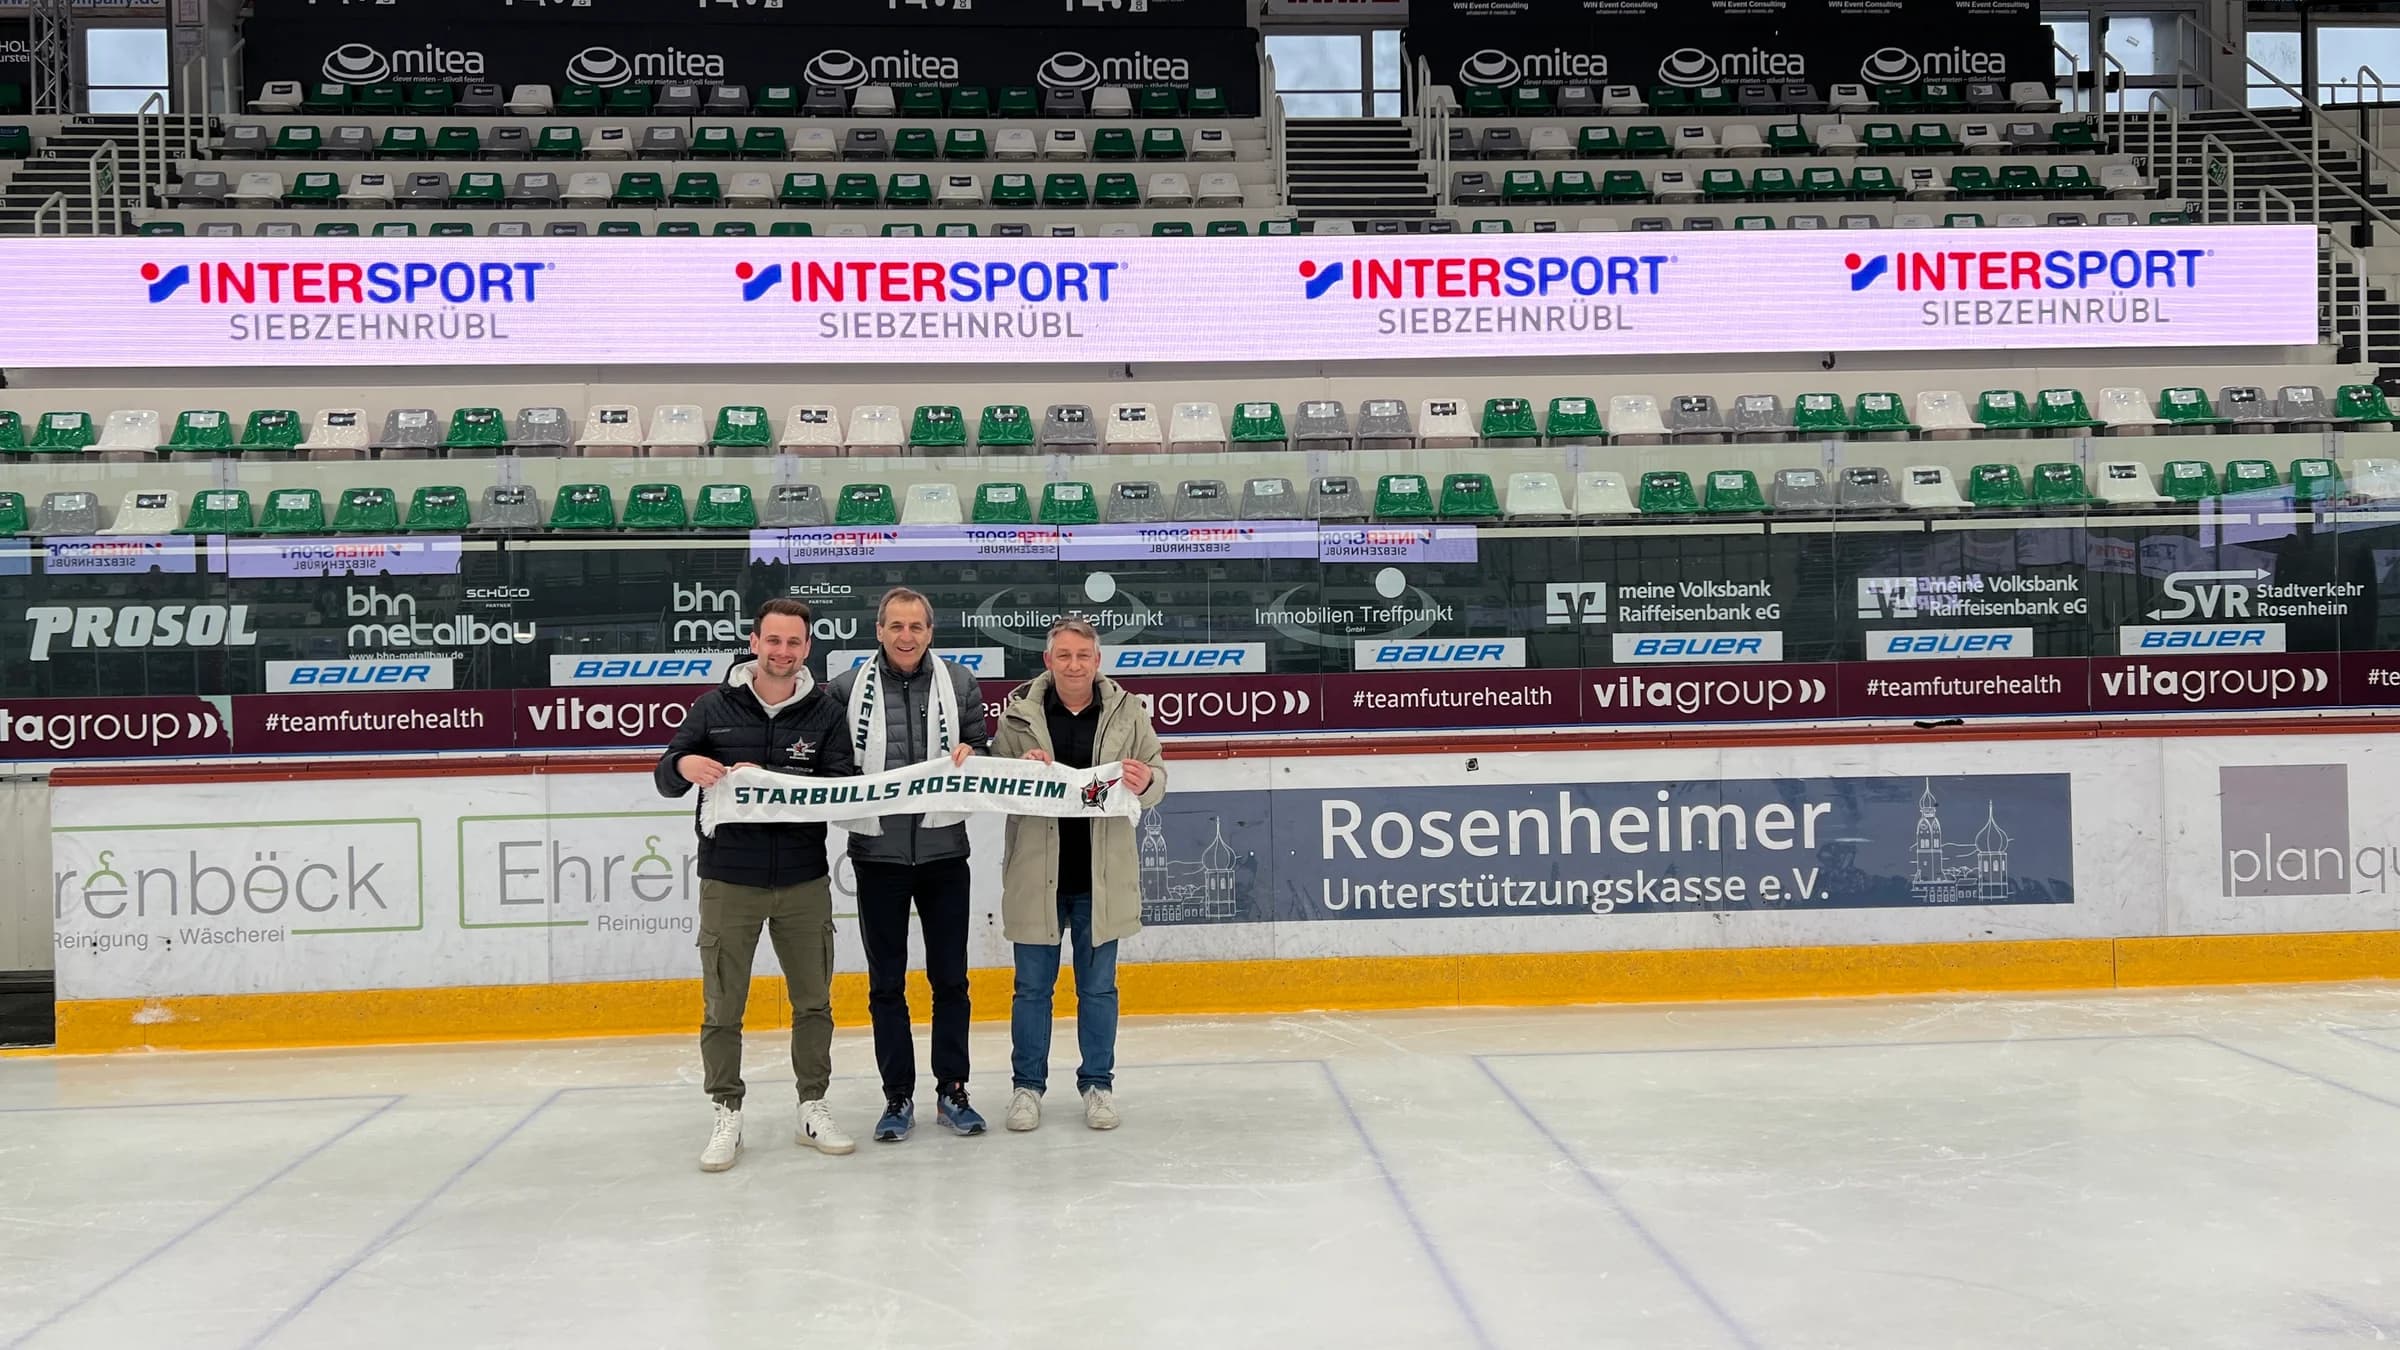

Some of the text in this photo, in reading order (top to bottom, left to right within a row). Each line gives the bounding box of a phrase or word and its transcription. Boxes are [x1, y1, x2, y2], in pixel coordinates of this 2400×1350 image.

[392, 43, 485, 74] mitea
[635, 46, 725, 76] mitea
[871, 49, 959, 79] mitea
[1103, 51, 1189, 81] mitea
[1523, 48, 1608, 76] mitea
[1721, 47, 1805, 75] mitea
[1924, 46, 2006, 74] mitea
[201, 262, 546, 303] INTERSPORT
[792, 261, 1118, 302] INTERSPORT
[1352, 256, 1668, 299] INTERSPORT
[1896, 250, 2205, 291] INTERSPORT
[230, 305, 509, 341] SIEBZEHNRÜBL
[819, 305, 1084, 339] SIEBZEHNRÜBL
[1378, 299, 1633, 334] SIEBZEHNRÜBL
[1922, 292, 2170, 325] SIEBZEHNRÜBL
[466, 585, 530, 598] SCHÜCO
[673, 582, 741, 612] bhn
[790, 582, 852, 594] SCHÜCO
[1619, 580, 1771, 599] meine Volksbank
[1989, 574, 2079, 593] Volksbank
[2155, 569, 2258, 620] SVR
[2256, 582, 2365, 598] Stadtverkehr
[346, 587, 416, 617] bhn
[1255, 605, 1453, 625] Immobilien Treffpunkt
[1619, 603, 1780, 622] Raiffeisenbank eG
[1930, 598, 2088, 617] Raiffeisenbank eG
[25, 605, 257, 661] PROSOL
[347, 615, 536, 647] metallbau
[1887, 633, 2013, 653] BAUER
[2140, 629, 2266, 648] BAUER
[1116, 648, 1245, 668] BAUER
[1375, 643, 1505, 663] BAUER
[1634, 637, 1763, 656] BAUER
[289, 665, 431, 685] BAUER
[573, 660, 712, 678] BAUER
[1352, 686, 1552, 708] #teamfuturehealth
[1592, 675, 1793, 714] vitagroup
[1867, 674, 2062, 696] #teamfuturehealth
[2101, 665, 2296, 703] vitagroup
[265, 708, 485, 733] #teamfuturehealth
[528, 697, 687, 737] vitagro
[734, 775, 1067, 805] STARBULLS ROSENHEIM
[1320, 790, 1832, 862] Rosenheimer
[1323, 866, 1829, 914] Unterstützungskasse e.V.
[179, 926, 285, 947] Wäscherei
[597, 913, 693, 937] Reinigung
